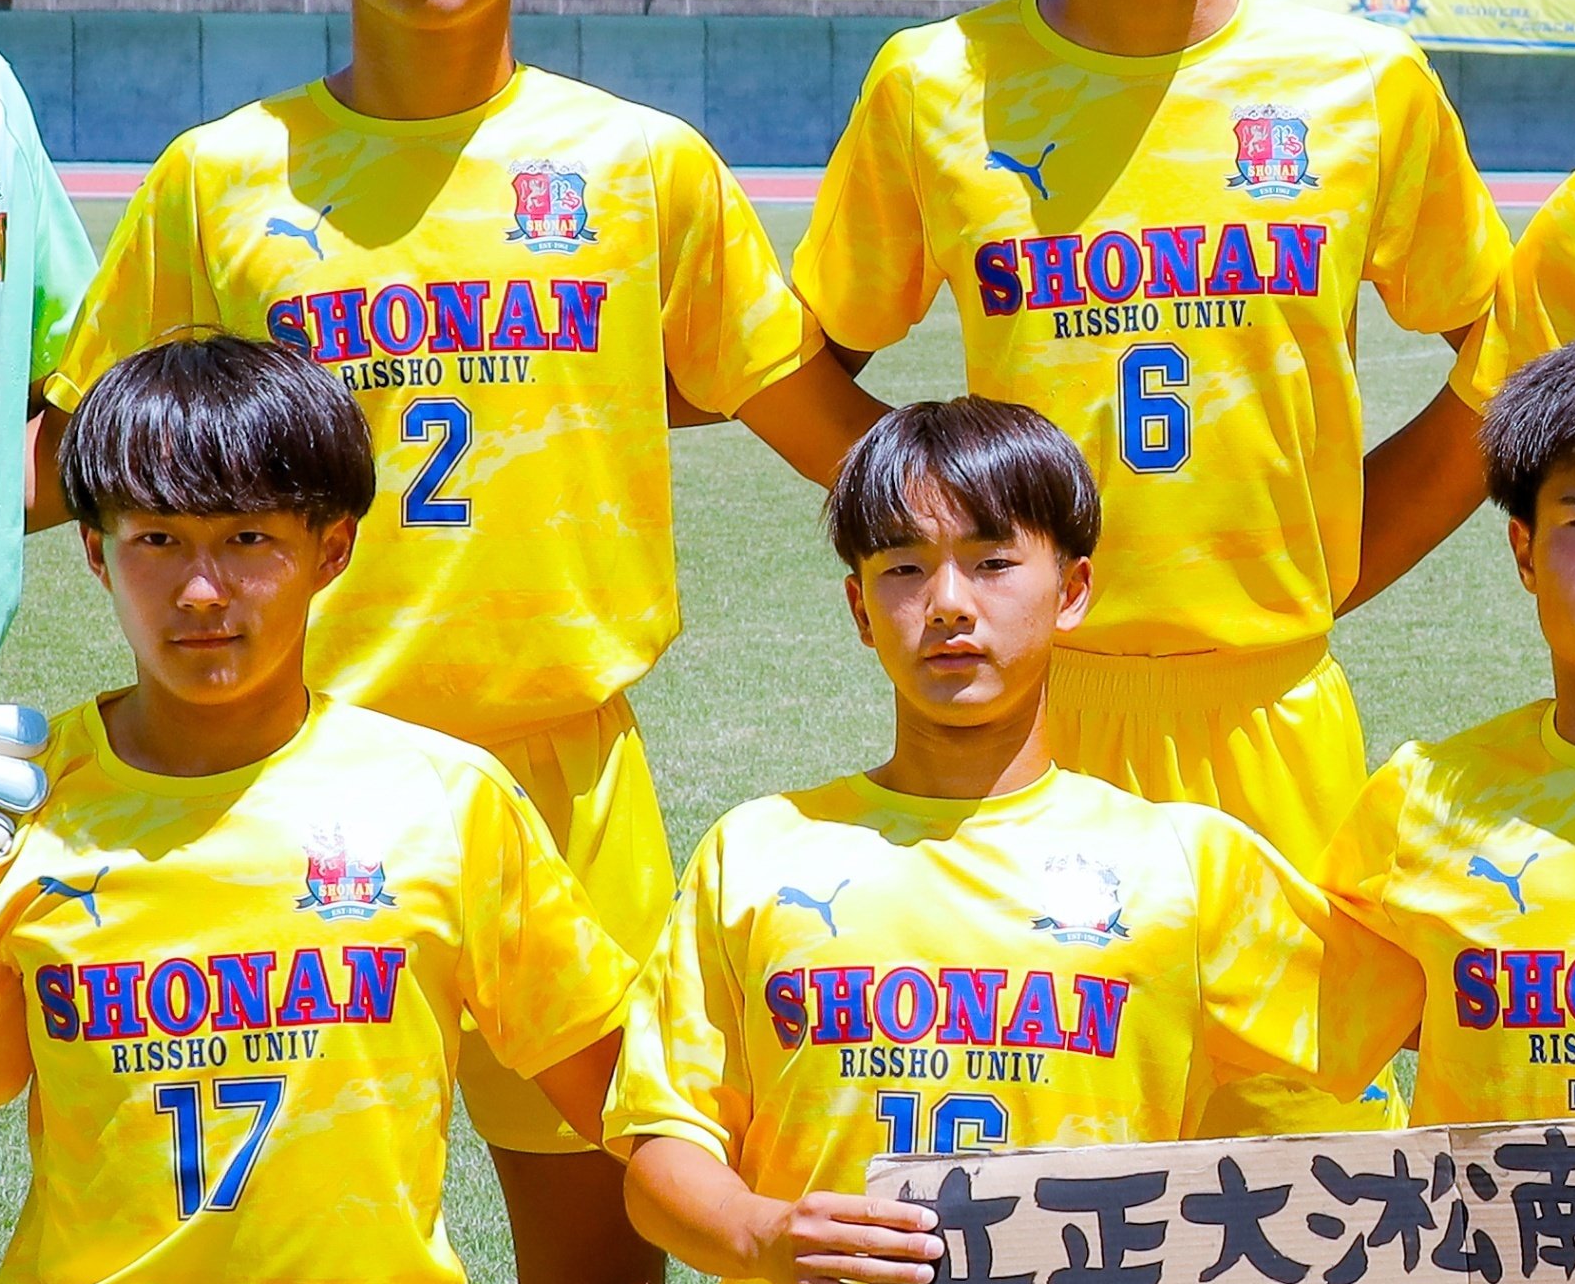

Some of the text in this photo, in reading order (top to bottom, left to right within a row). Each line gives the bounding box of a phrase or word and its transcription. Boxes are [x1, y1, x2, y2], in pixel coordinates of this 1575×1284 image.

[1247, 164, 1299, 177] SHONAN
[526, 218, 577, 233] SHONAN
[975, 223, 1326, 317] SHONAN
[267, 280, 607, 363] SHONAN
[1053, 300, 1253, 339] RISSHO UNIV.
[342, 356, 536, 392] RISSHO UNIV.
[1118, 342, 1190, 474] 6
[401, 397, 472, 528] 2
[318, 882, 375, 897] SHONAN
[36, 946, 406, 1042] SHONAN
[765, 966, 1129, 1058] SHONAN
[112, 1029, 325, 1074] RISSHO UNIV.
[840, 1047, 1049, 1084] RISSHO UNIV.
[154, 1075, 287, 1221] 17
